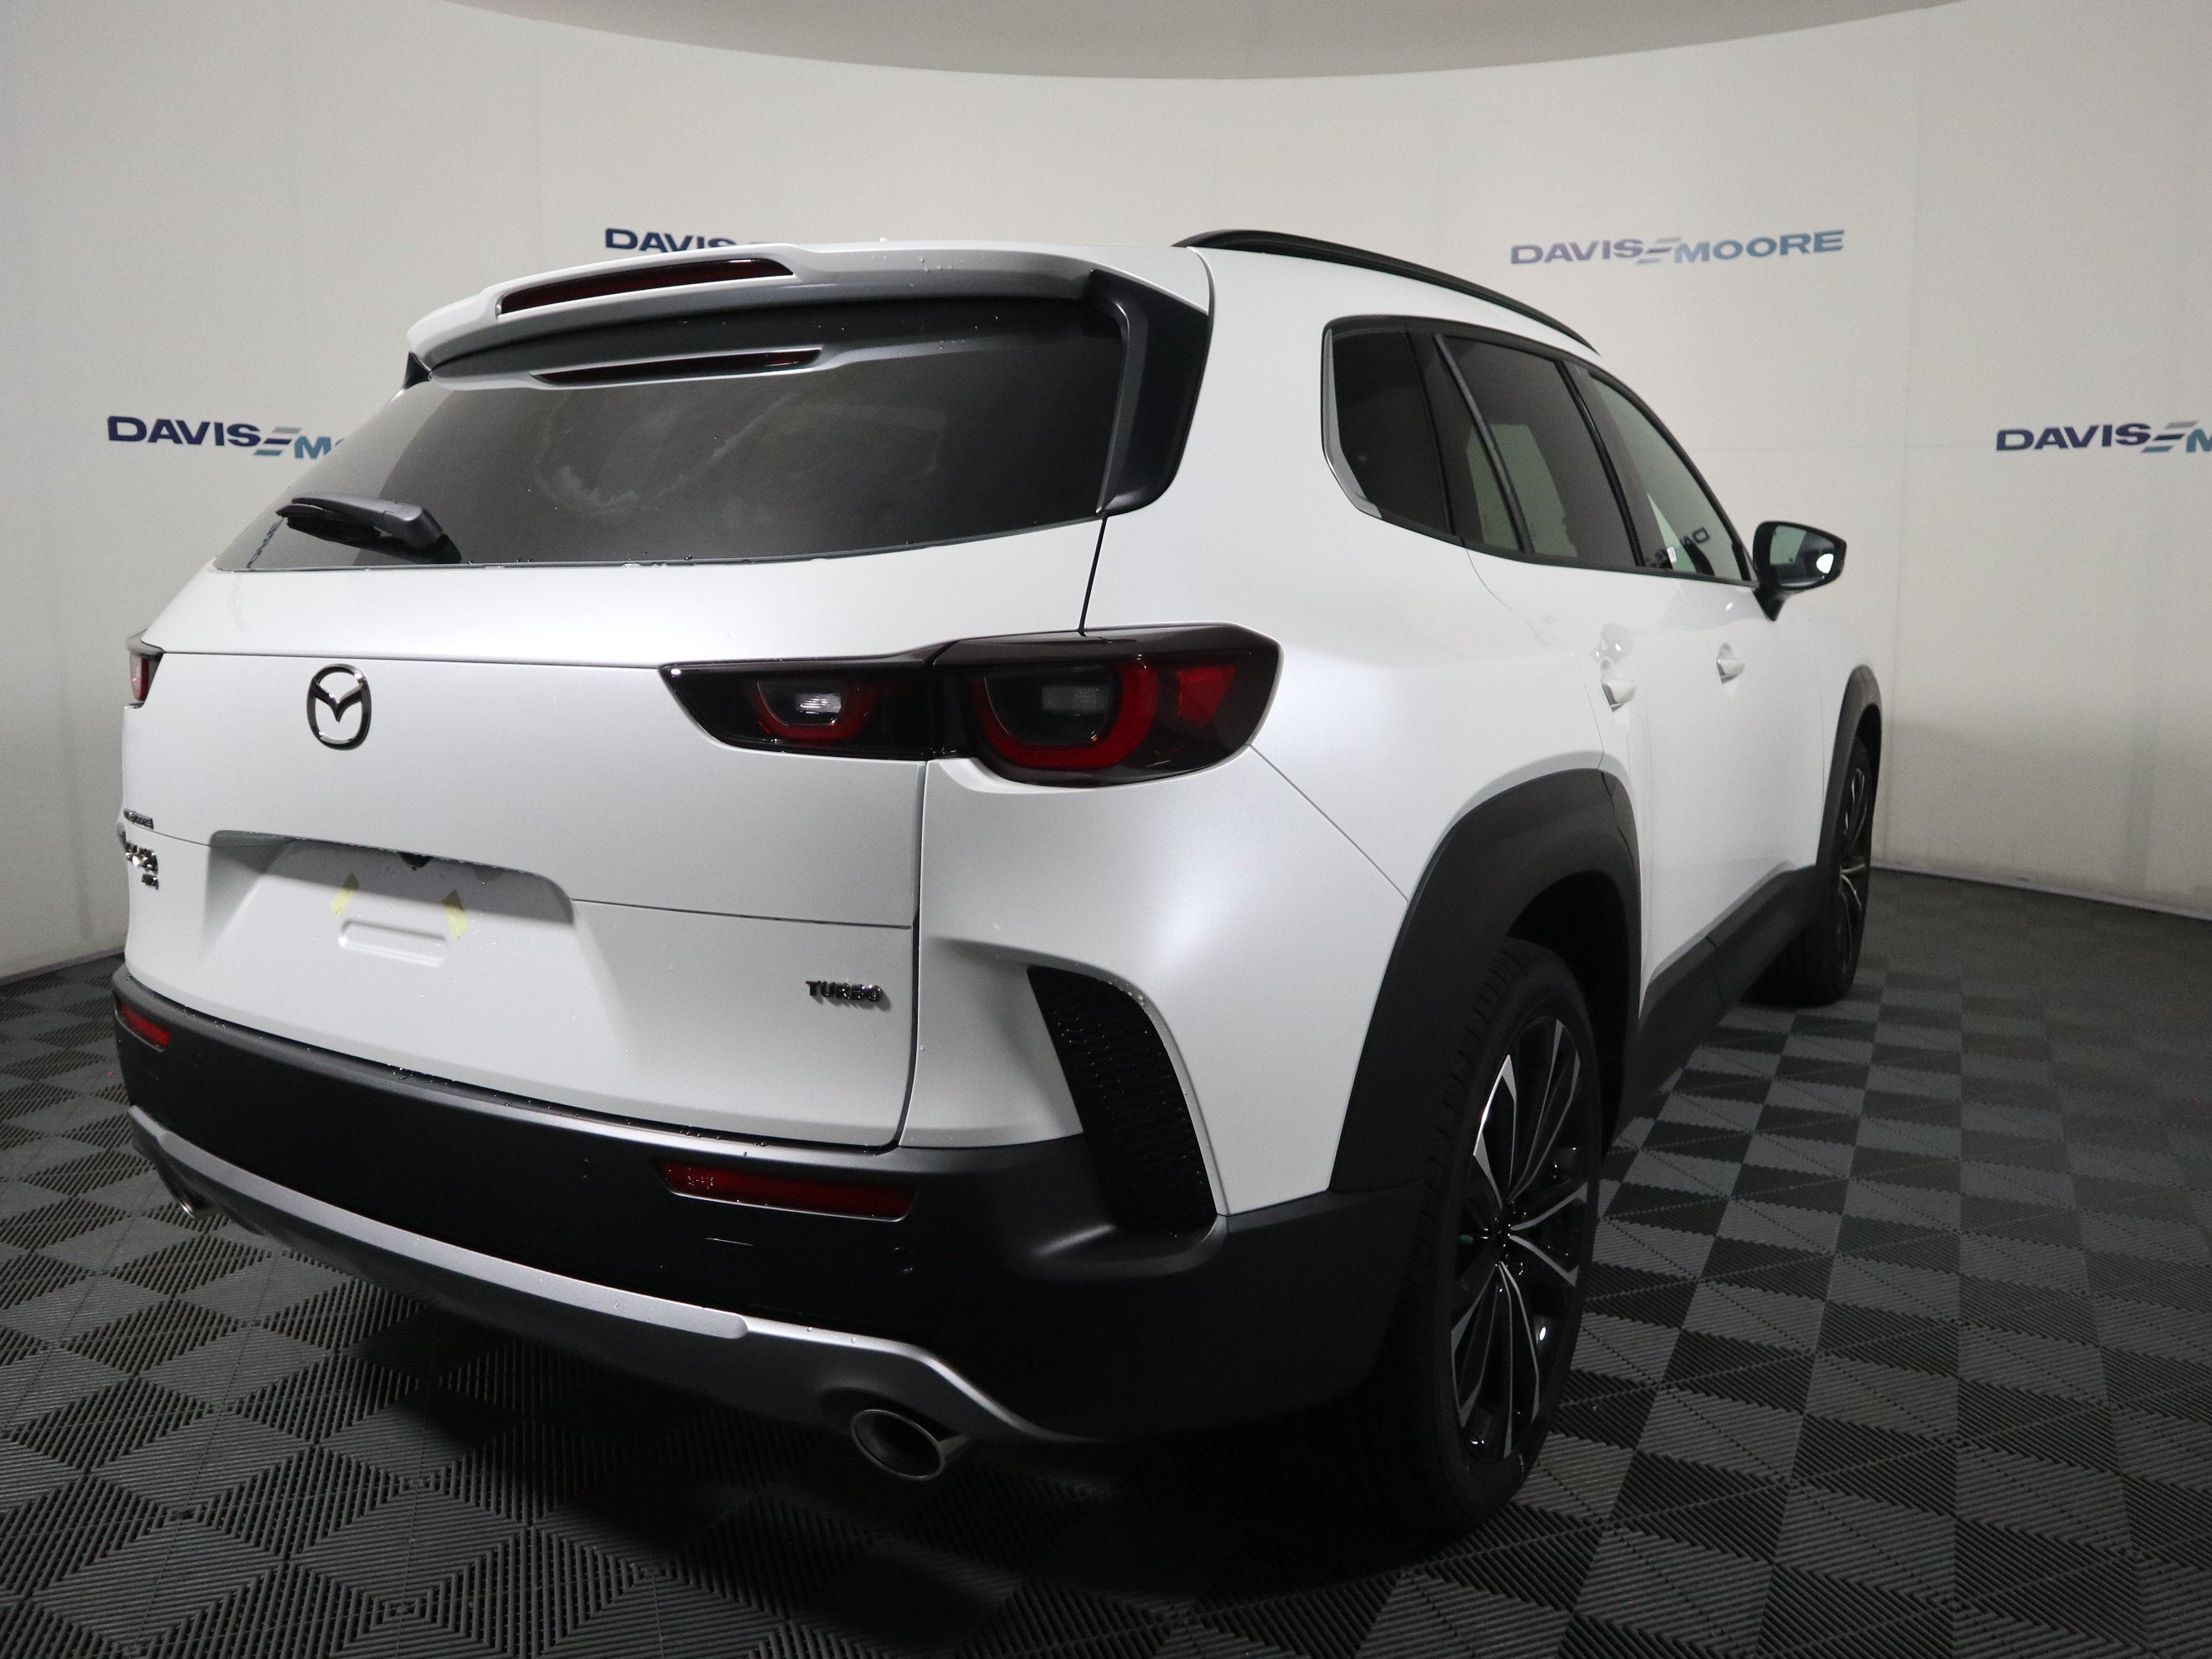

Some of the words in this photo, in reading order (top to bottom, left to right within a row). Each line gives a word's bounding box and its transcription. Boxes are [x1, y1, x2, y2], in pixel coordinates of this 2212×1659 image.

[1510, 238, 1644, 265] DAVIS
[1674, 229, 1845, 265] MOORE
[107, 415, 261, 447] DAVIS
[294, 435, 343, 459] M
[1996, 422, 2152, 451] DAVIS
[805, 980, 883, 1002] TURBO
